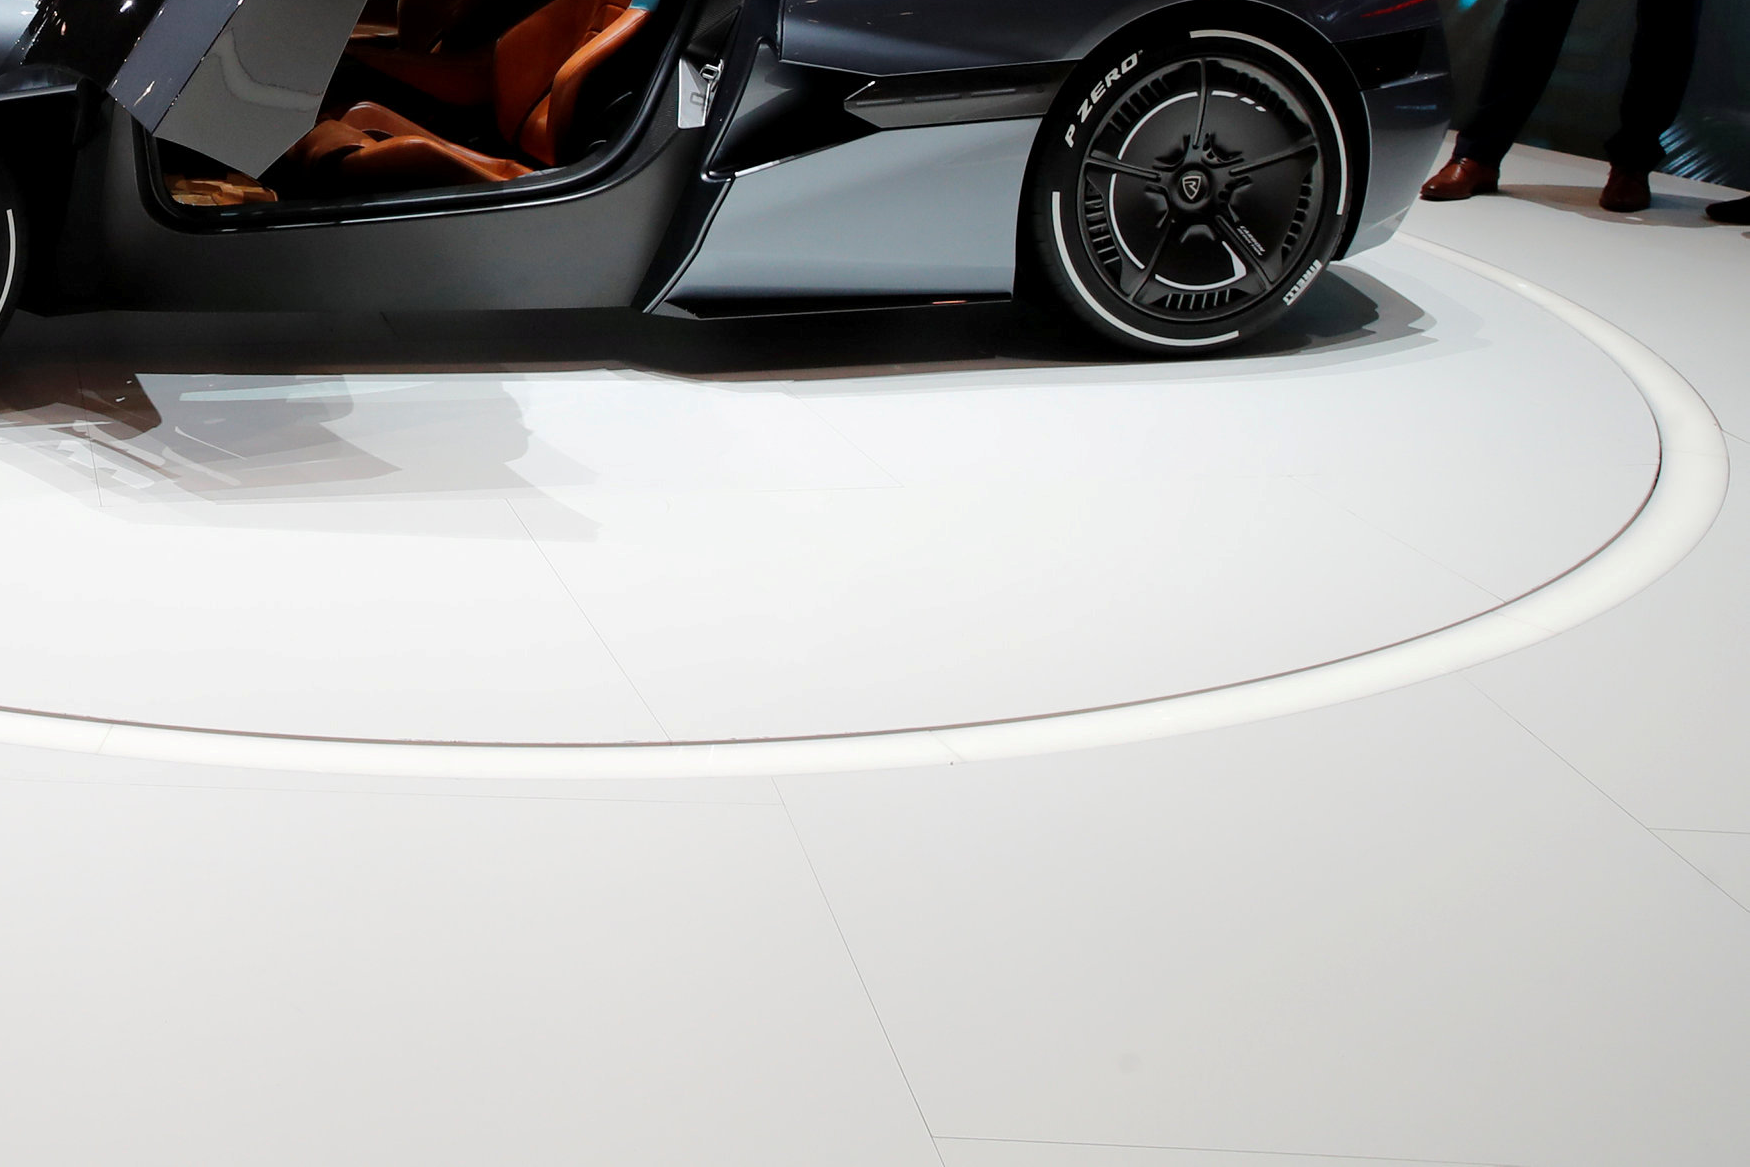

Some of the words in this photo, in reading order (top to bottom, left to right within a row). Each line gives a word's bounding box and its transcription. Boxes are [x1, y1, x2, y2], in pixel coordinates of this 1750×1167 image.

[1064, 124, 1076, 148] P
[1077, 52, 1138, 123] ZERO
[1282, 258, 1323, 306] PIRELLI
